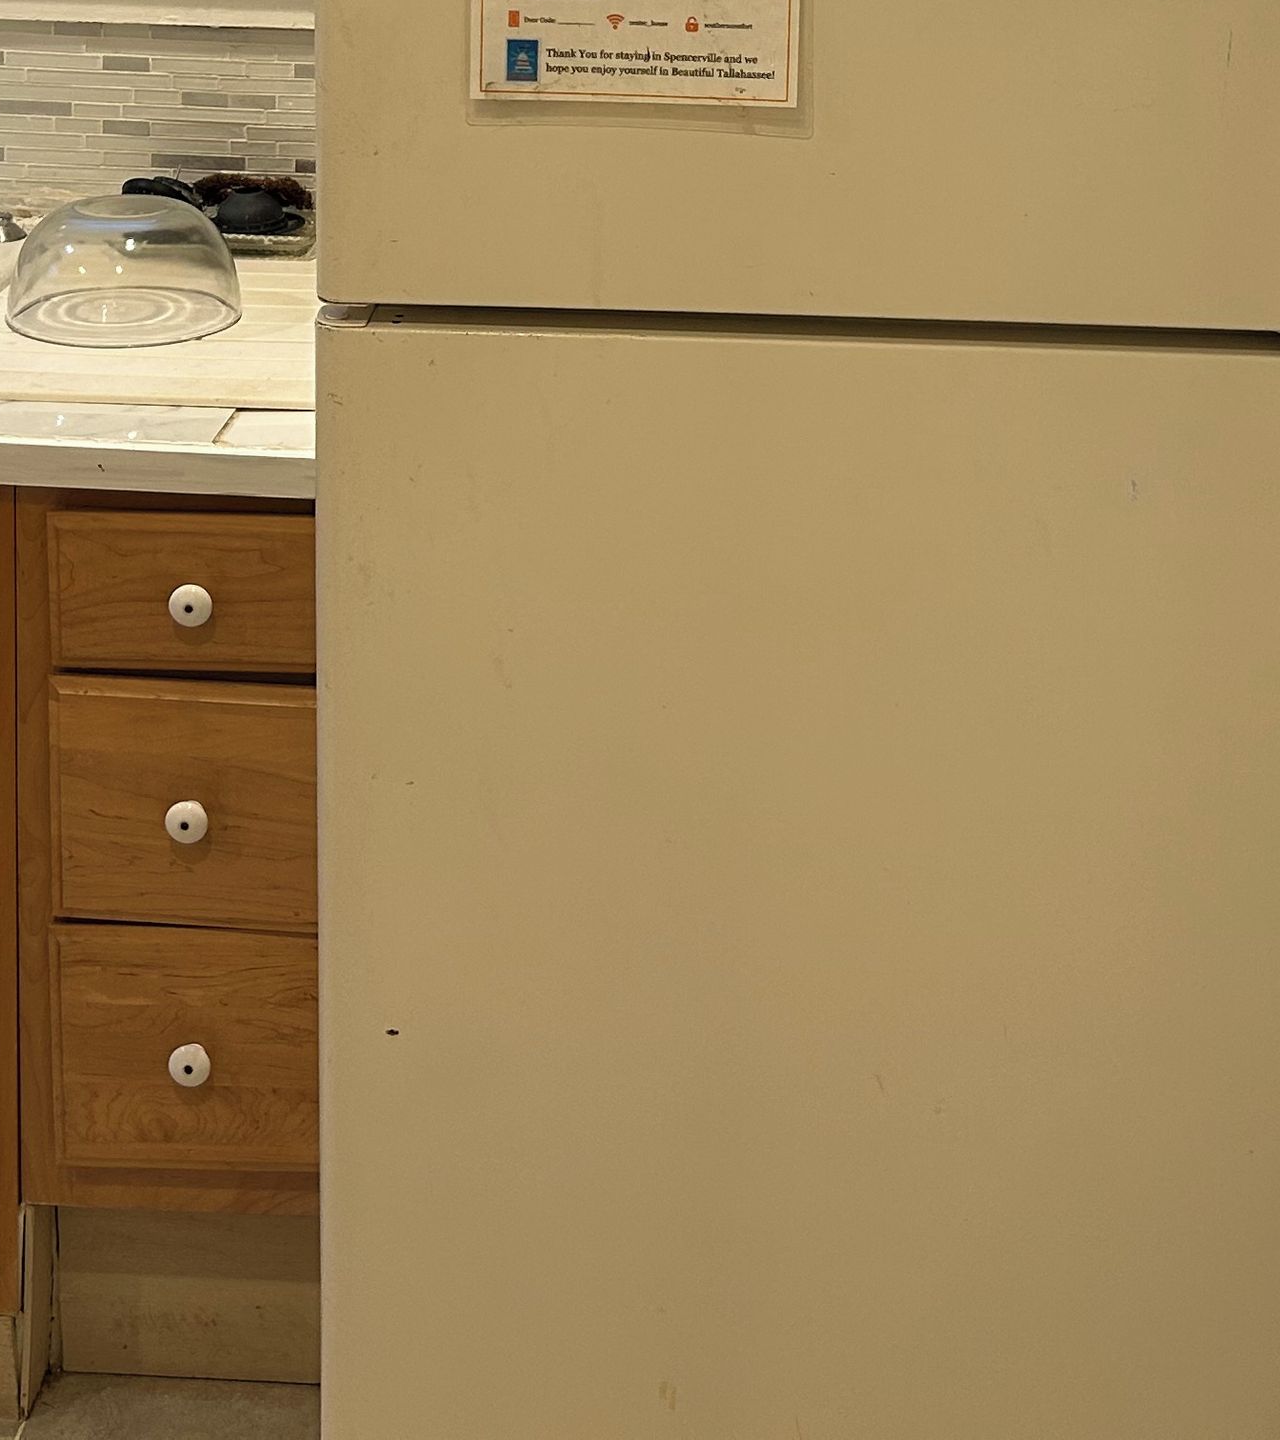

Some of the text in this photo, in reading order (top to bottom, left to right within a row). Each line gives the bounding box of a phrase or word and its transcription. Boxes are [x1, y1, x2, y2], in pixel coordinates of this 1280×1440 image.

[546, 47, 577, 57] Thank
[578, 48, 597, 58] You
[599, 49, 613, 59] for
[614, 49, 650, 62] staying
[651, 50, 661, 60] in
[663, 51, 722, 64] Spencerville
[723, 52, 742, 63] and
[546, 62, 776, 78] hope you enjoy yourself in Beautiful Tallahassee!
